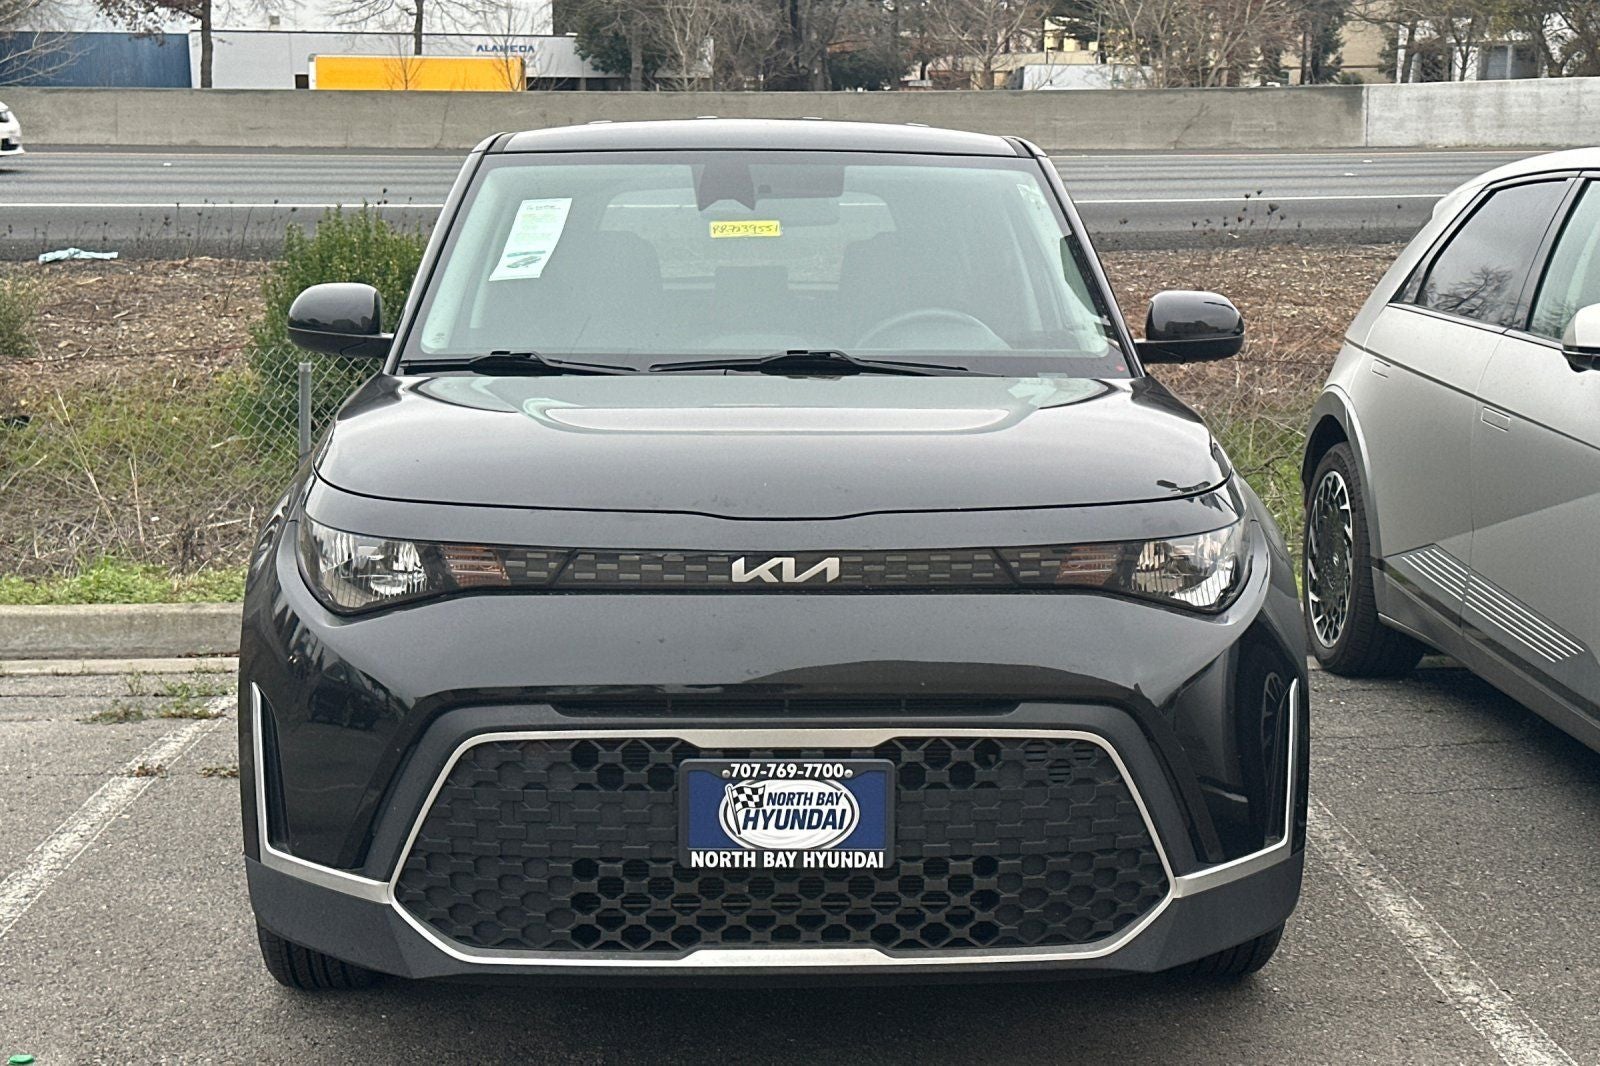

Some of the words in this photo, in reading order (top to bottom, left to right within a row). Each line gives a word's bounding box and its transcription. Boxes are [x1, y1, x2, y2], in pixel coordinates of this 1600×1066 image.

[731, 556, 840, 583] KIA
[730, 763, 844, 778] 707-769-7700
[766, 791, 813, 806] NORTH
[815, 791, 844, 806] BAY
[742, 808, 847, 830] HYUNDAI
[691, 851, 756, 868] NORTH
[763, 851, 798, 868] BAY
[803, 851, 884, 868] HYUNDAI
